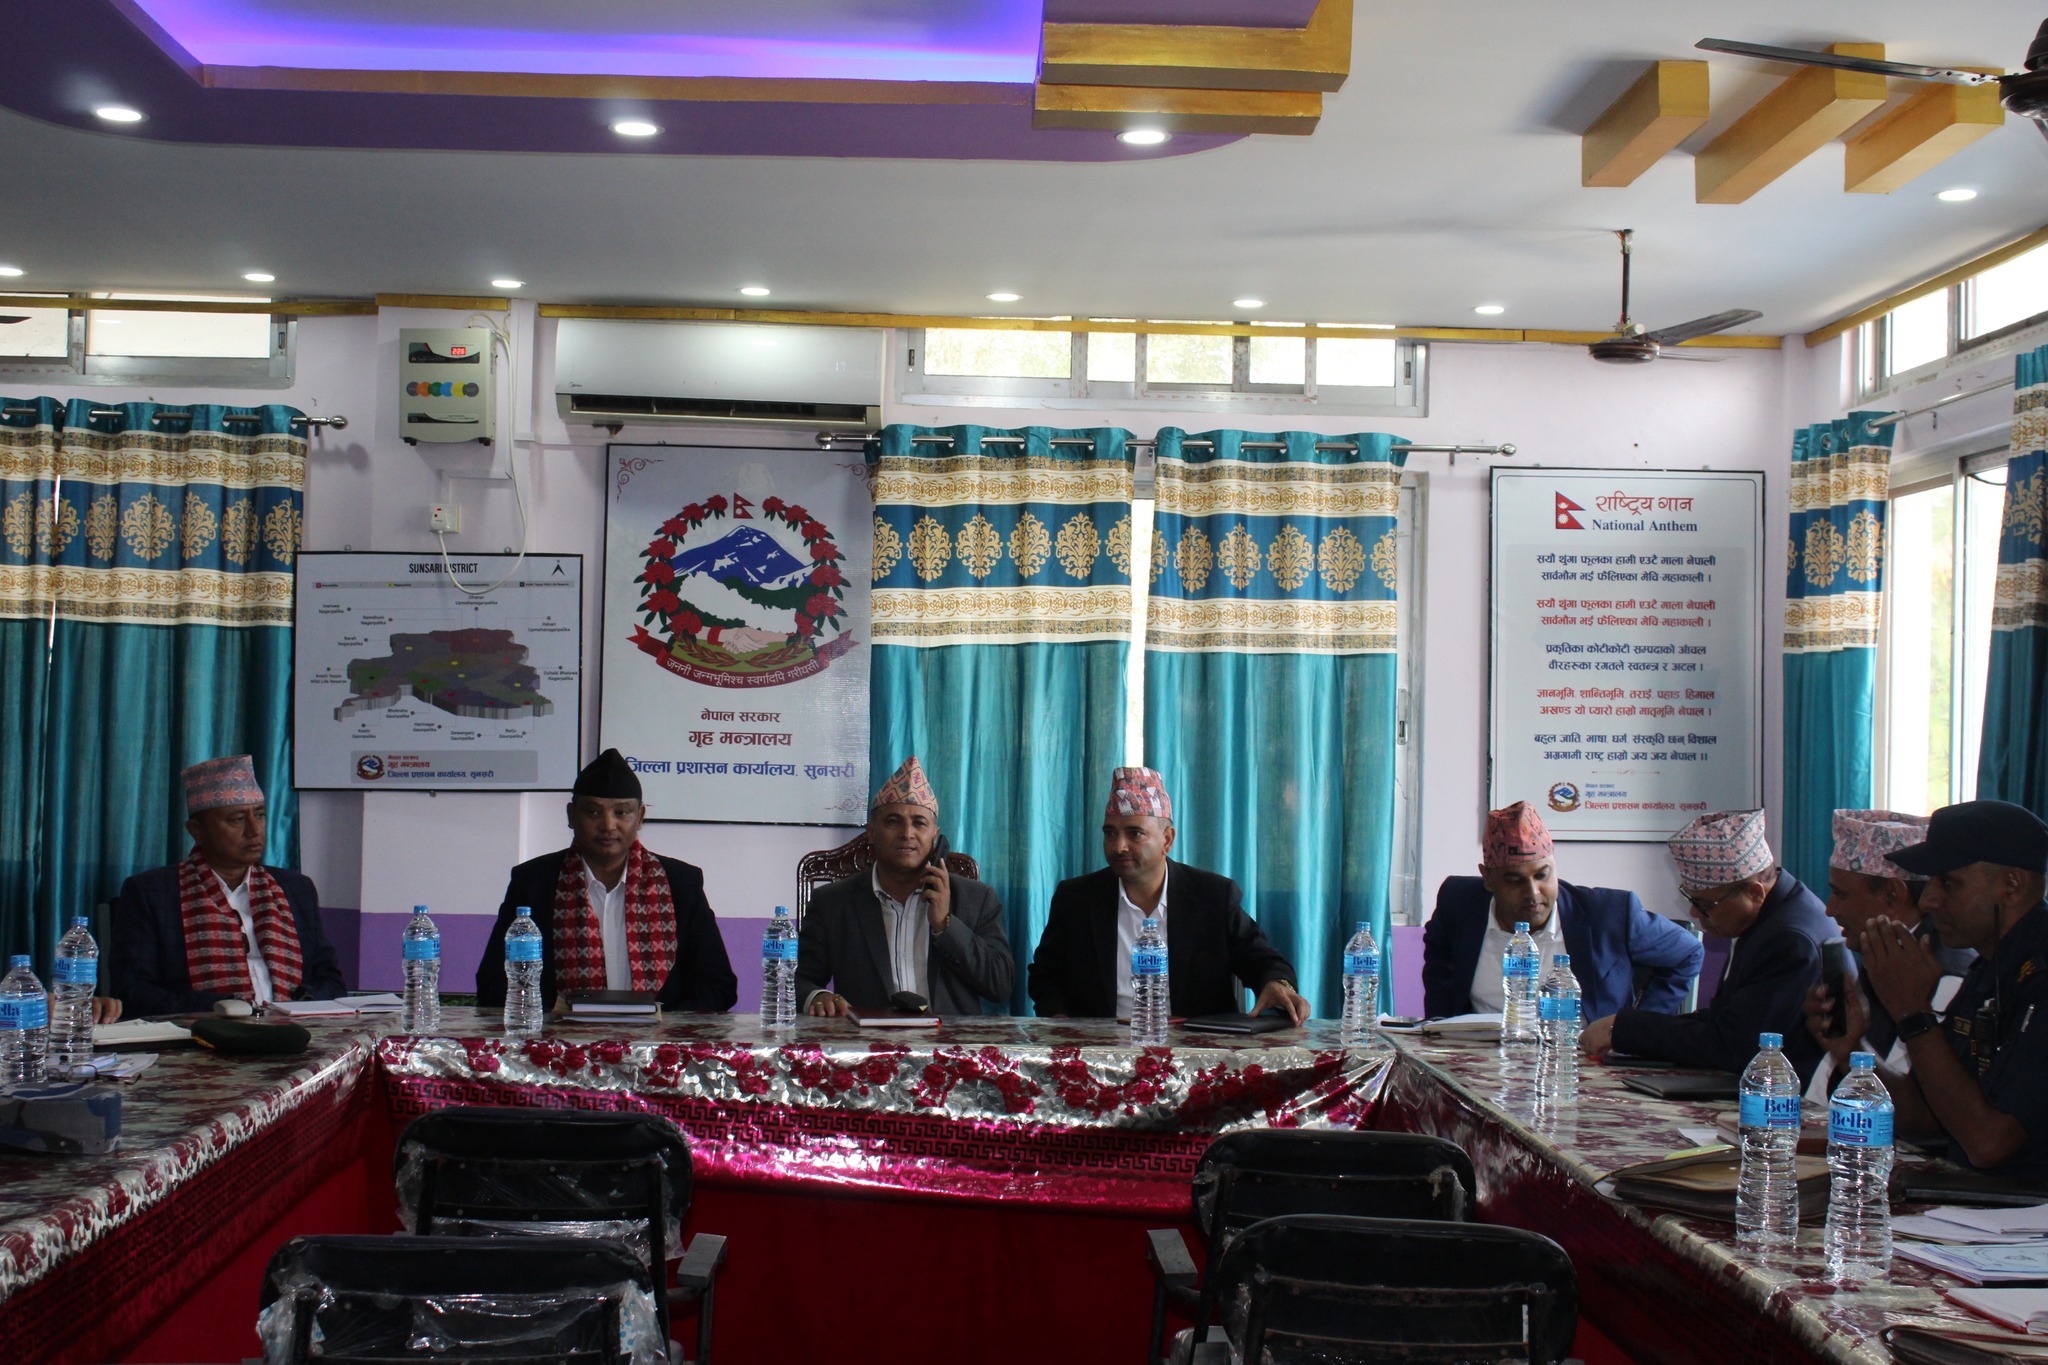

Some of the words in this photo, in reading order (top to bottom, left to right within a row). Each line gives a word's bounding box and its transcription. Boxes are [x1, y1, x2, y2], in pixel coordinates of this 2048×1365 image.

[452, 347, 465, 355] 226
[1595, 490, 1654, 515] राष्ट्रिय
[1658, 497, 1694, 512] गान
[1592, 519, 1644, 531] National
[1649, 520, 1698, 532] Anthem
[1615, 554, 1637, 566] हामी
[1660, 556, 1684, 566] माला
[1686, 554, 1716, 566] नेपाली
[409, 563, 442, 574] SUNSARI
[1615, 598, 1637, 610] हामी
[1660, 600, 1684, 610] माला
[1686, 599, 1716, 611] नेपाली
[666, 658, 691, 676] जननी
[1671, 662, 1697, 672] अटल
[1685, 688, 1715, 701] हिमाल
[700, 708, 734, 722] नेपाल
[739, 712, 782, 722] सरकार
[1575, 704, 1586, 716] यो
[1678, 704, 1704, 717] नेपाल
[689, 730, 715, 748] गृह
[720, 732, 793, 746] मन्त्रालय
[1688, 733, 1717, 746] विशाल
[1631, 752, 1648, 761] जय
[1651, 752, 1668, 761] जय
[1670, 750, 1697, 762] नेपाल
[626, 756, 672, 774] जिल्ला
[676, 761, 728, 775] प्रशासन
[804, 762, 856, 780] सुनसरी
[1765, 1098, 1799, 1114] Bella
[1832, 1110, 1872, 1130] Bella
